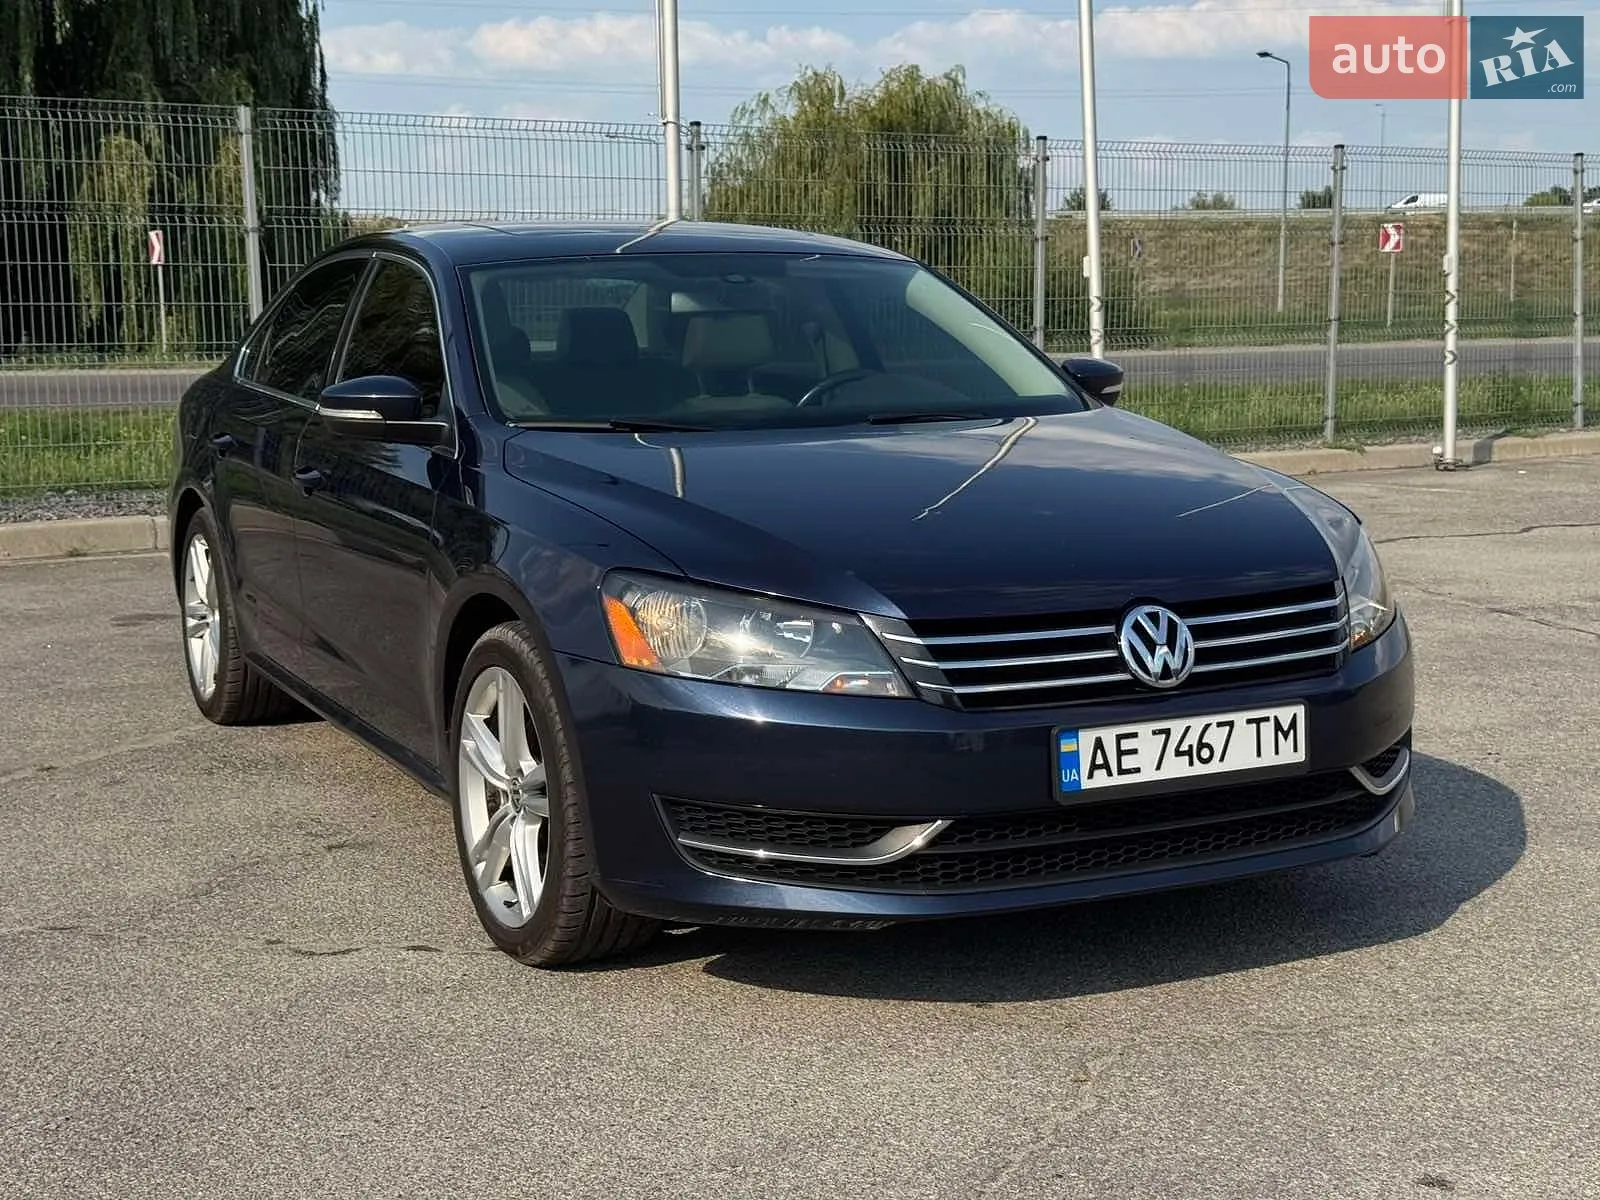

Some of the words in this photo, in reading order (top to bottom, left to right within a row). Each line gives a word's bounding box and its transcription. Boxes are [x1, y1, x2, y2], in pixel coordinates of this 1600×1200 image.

[1122, 606, 1194, 687] VW
[1061, 769, 1079, 783] UA
[1087, 732, 1141, 780] AE
[1151, 720, 1235, 771] 7467
[1245, 713, 1298, 758] TM
